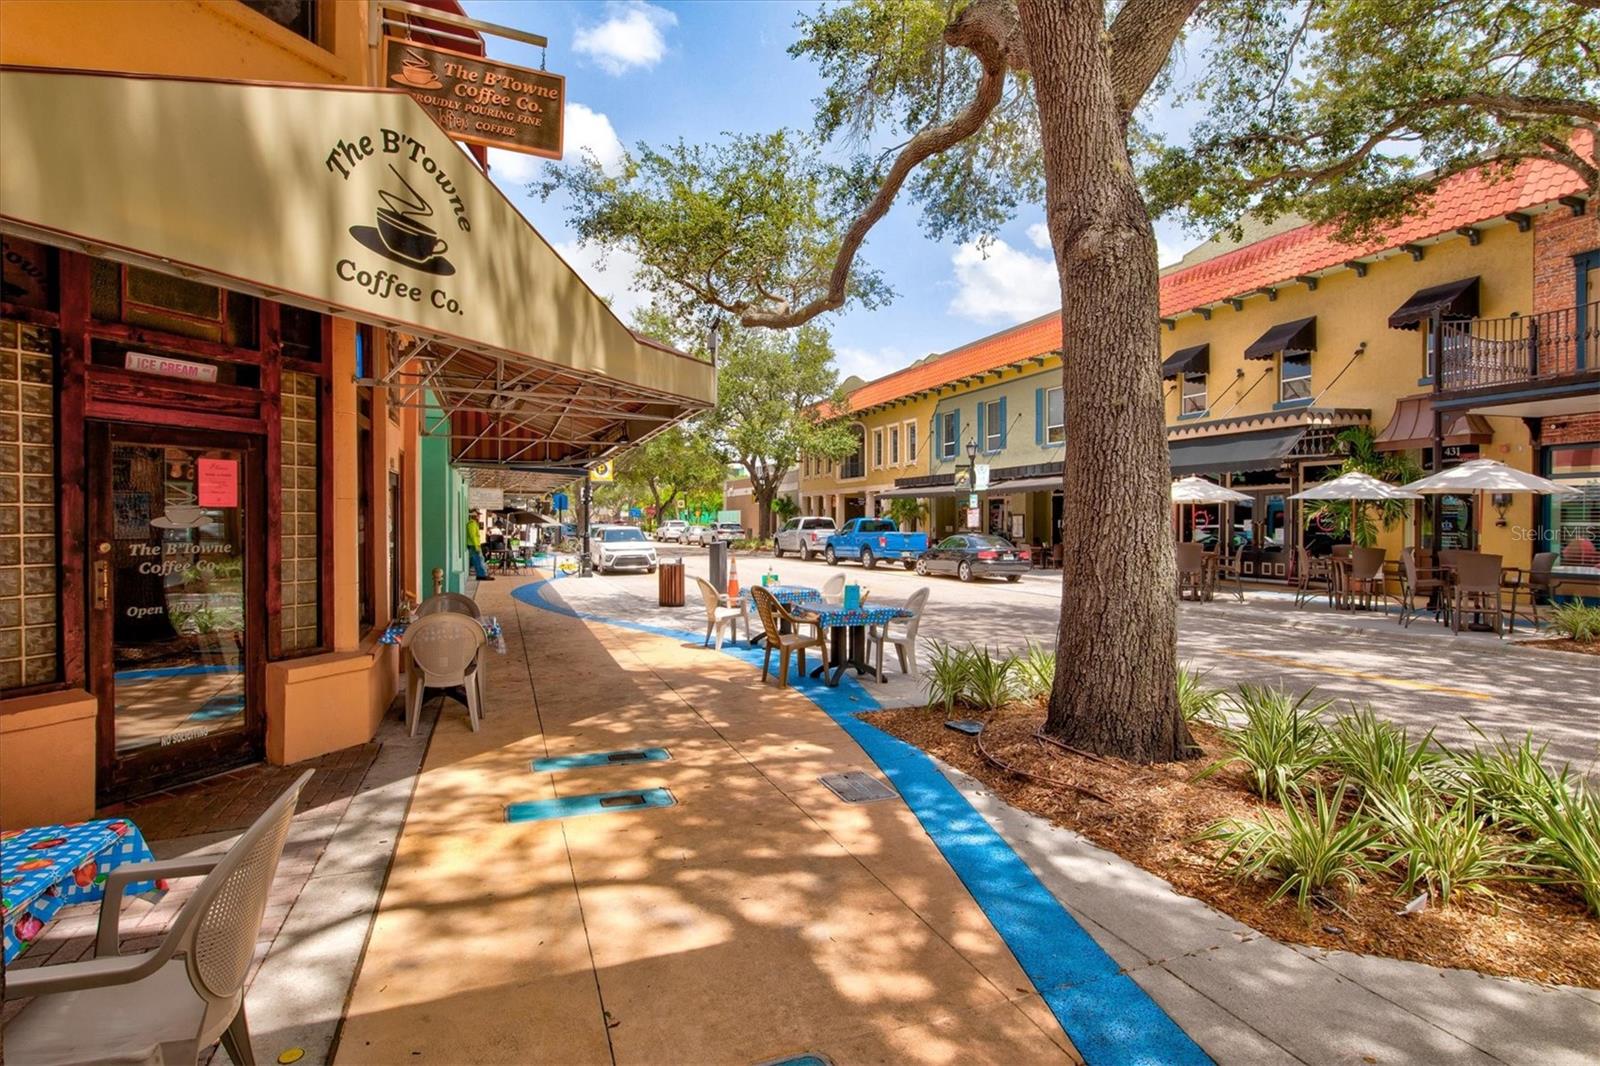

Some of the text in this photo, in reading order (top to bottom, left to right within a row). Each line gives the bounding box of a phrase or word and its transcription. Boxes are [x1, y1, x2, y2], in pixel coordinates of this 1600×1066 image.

[445, 62, 559, 99] The B'Towne
[455, 83, 543, 113] Coffee Co.
[465, 103, 515, 122] POURING
[517, 115, 543, 127] FINE
[475, 121, 517, 137] COFFEE
[325, 128, 472, 233] The B'Towne
[336, 259, 464, 316] Coffee Co.
[136, 357, 157, 370] ICE
[160, 361, 199, 377] CREAM
[1444, 447, 1460, 457] 431
[129, 542, 232, 557] The B'Towne
[139, 560, 191, 576] Coffee
[126, 606, 164, 619] Open
